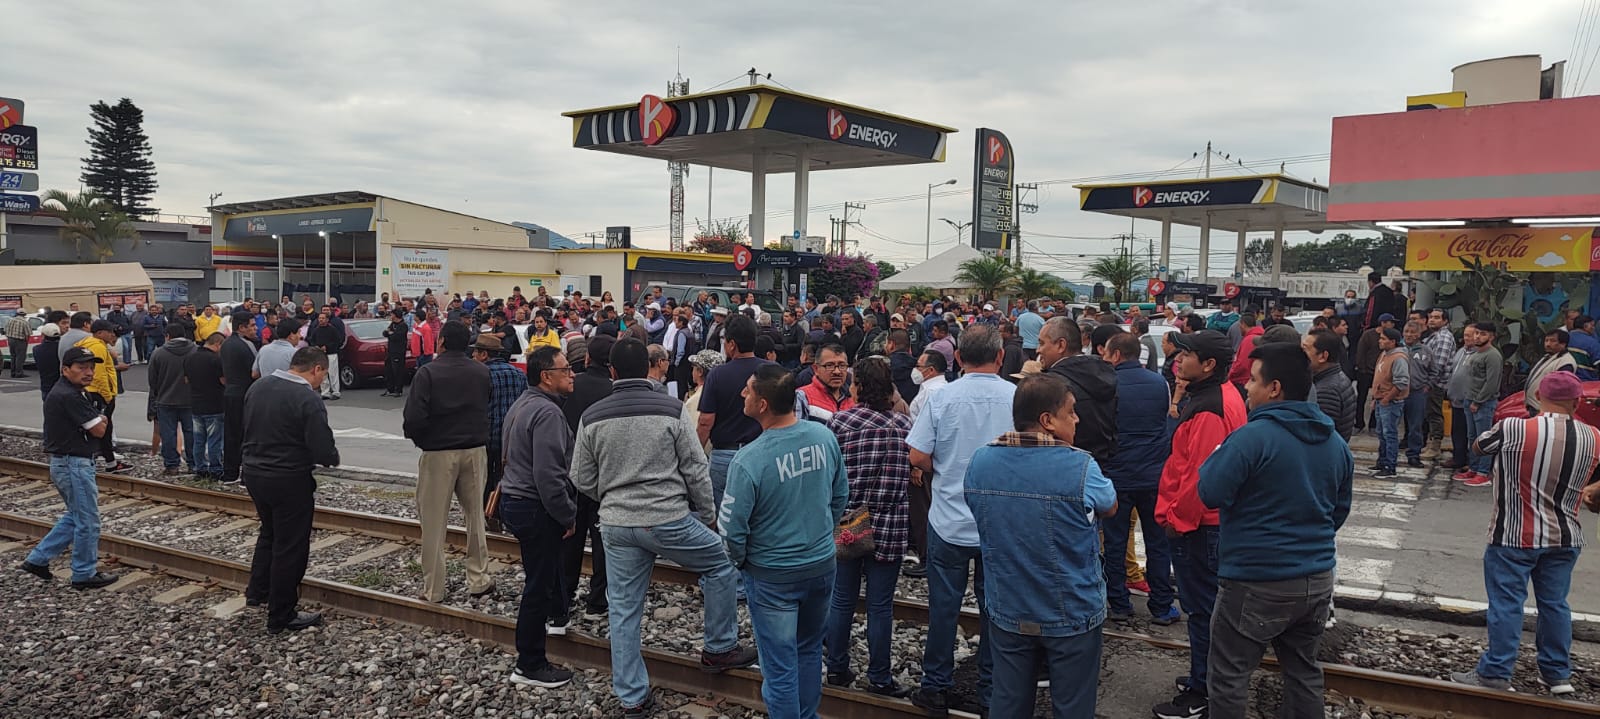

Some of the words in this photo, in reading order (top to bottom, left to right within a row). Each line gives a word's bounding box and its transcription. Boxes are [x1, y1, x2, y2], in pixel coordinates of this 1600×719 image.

[848, 123, 897, 148] ENERGY
[3, 174, 19, 185] 24
[984, 168, 1007, 179] ENERGY
[1154, 190, 1209, 204] ENERGY
[4, 200, 30, 208] Wash
[1447, 234, 1535, 258] Coca-Cola
[737, 250, 748, 265] 6
[1151, 282, 1161, 292] 4
[1227, 286, 1237, 296] 2
[776, 445, 827, 482] KLEIN
